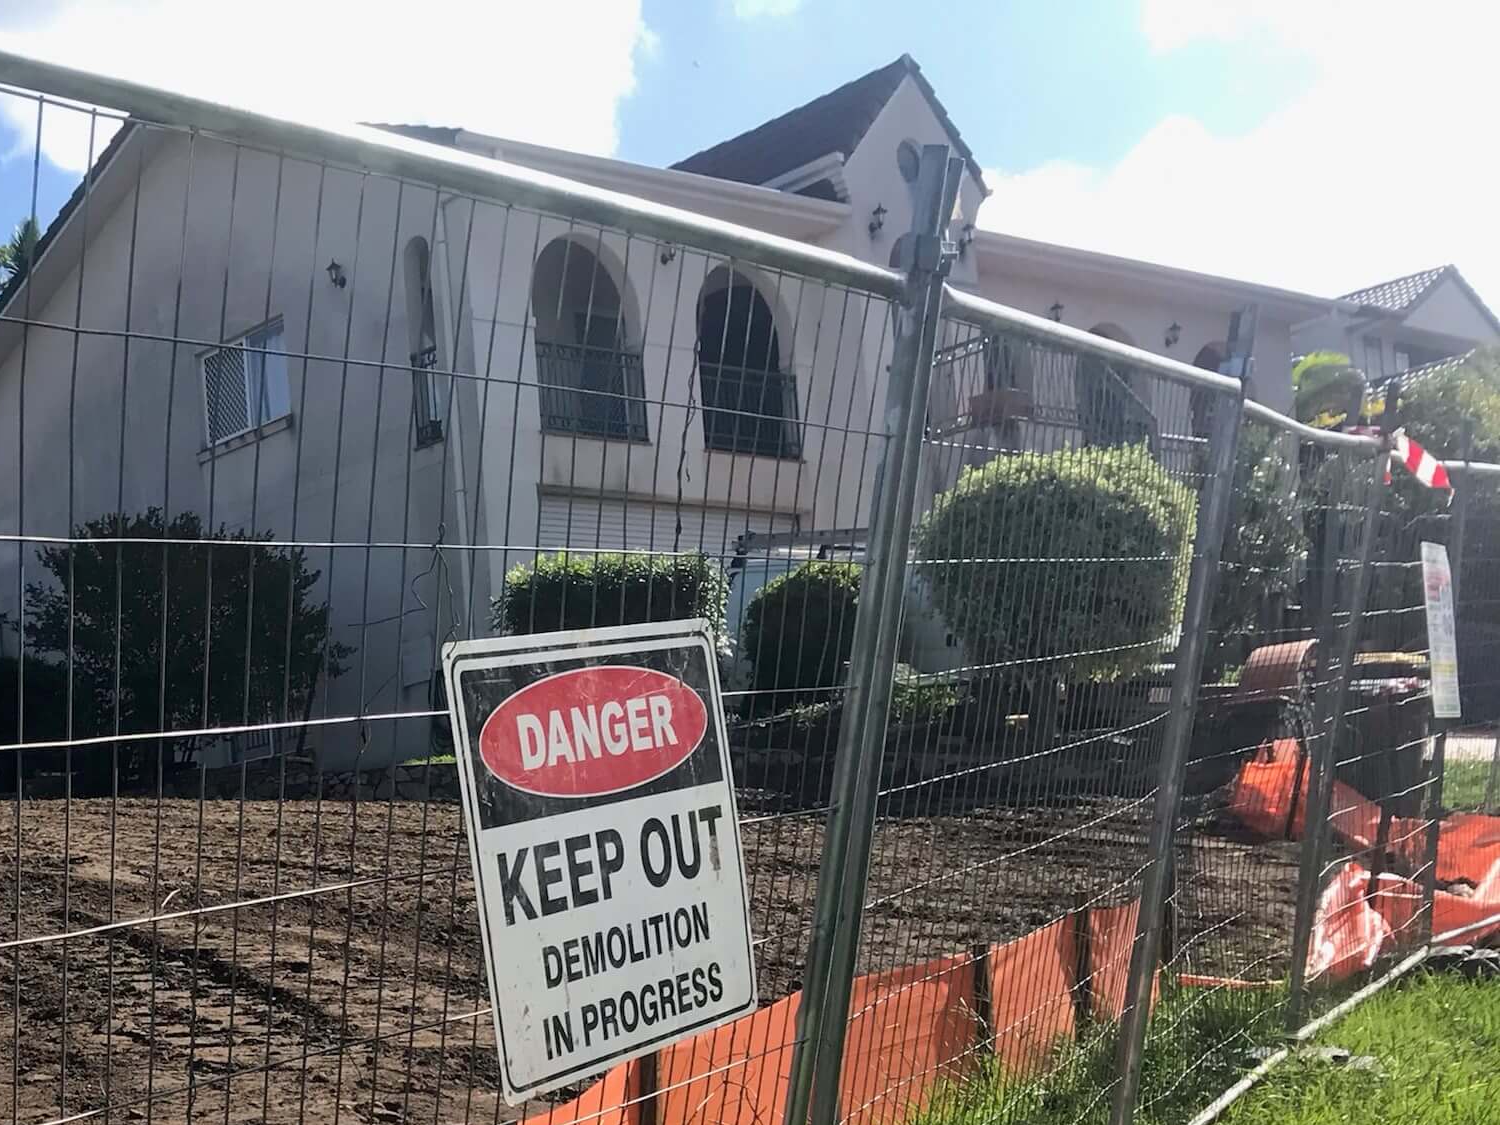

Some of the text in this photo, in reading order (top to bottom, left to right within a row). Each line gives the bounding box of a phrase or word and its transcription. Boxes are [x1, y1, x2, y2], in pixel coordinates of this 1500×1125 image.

[516, 694, 678, 771] DANGER
[496, 804, 723, 927] KEEP OUT
[542, 901, 711, 990] DEMOLITION
[542, 962, 725, 1061] IN PROGRESS
